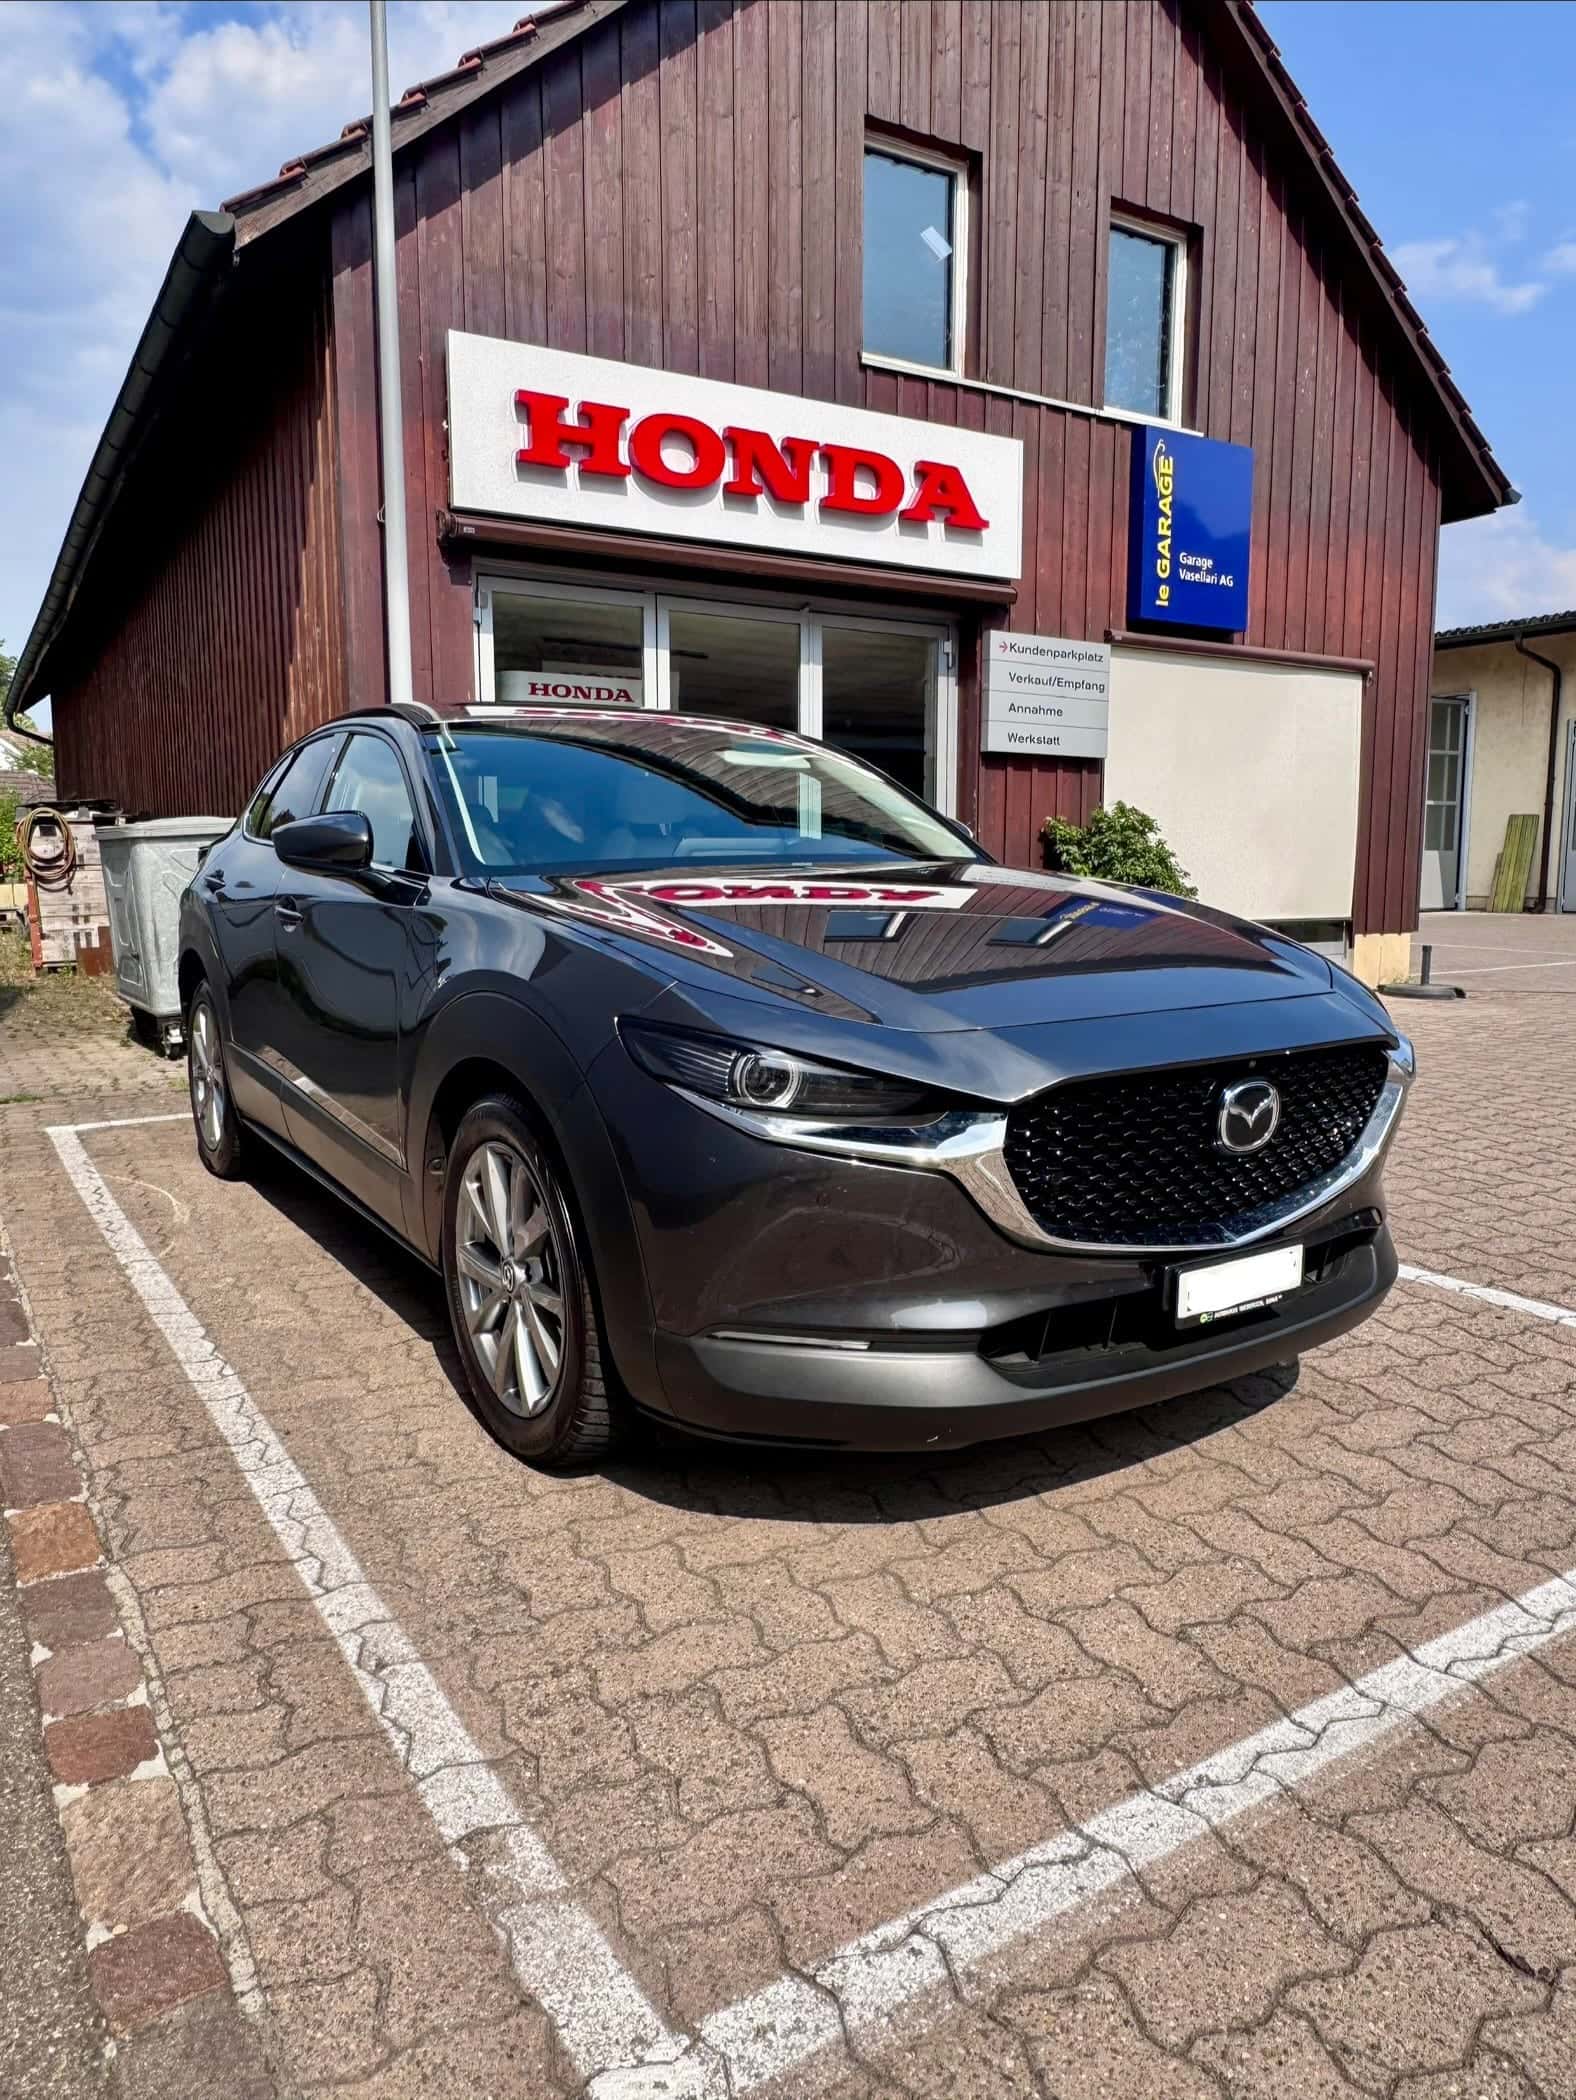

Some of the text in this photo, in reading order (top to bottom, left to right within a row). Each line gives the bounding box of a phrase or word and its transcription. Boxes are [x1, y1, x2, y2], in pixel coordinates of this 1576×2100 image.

[514, 388, 990, 532] HONDA
[1155, 455, 1174, 606] le GARAGE
[1179, 551, 1214, 570] Garage
[1178, 568, 1234, 587] Vasellari AG
[1009, 642, 1104, 663] Kundenparkplatz
[528, 682, 635, 703] HONDA
[1008, 671, 1105, 693] Verkauf/Empfang
[1008, 702, 1064, 717] Annahme
[1007, 732, 1061, 746] Werkstatt
